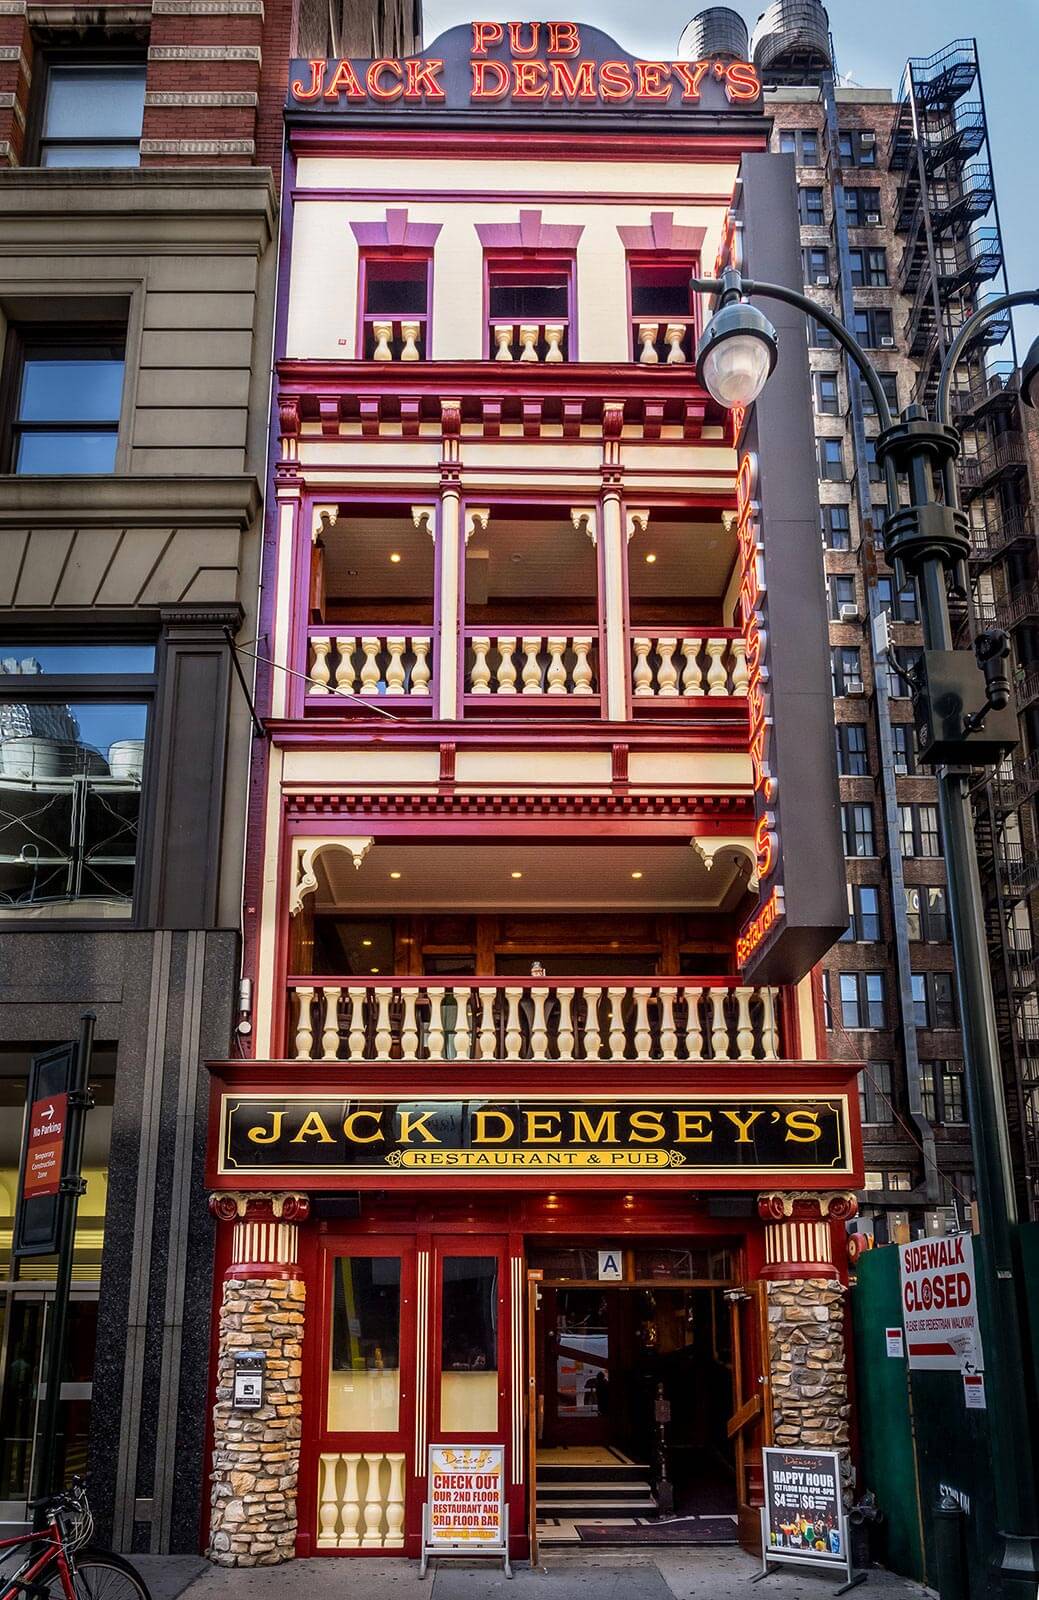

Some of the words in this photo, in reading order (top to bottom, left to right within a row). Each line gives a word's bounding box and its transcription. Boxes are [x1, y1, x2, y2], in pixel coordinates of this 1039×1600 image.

[472, 21, 581, 57] PUB
[292, 60, 446, 101] JACK
[472, 60, 760, 102] DEMSEY'S
[33, 1127, 41, 1137] No
[41, 1121, 62, 1135] Parking
[248, 1111, 442, 1144] JACK
[471, 1110, 823, 1144] DEMSEY'S
[34, 1150, 55, 1161] Temporary
[414, 1153, 578, 1165] RESTAURANT
[587, 1153, 601, 1165] &
[611, 1153, 659, 1165] PUB
[31, 1160, 56, 1171] Construction
[904, 1236, 965, 1274] SIDEWALK
[602, 1255, 619, 1273] A
[904, 1272, 971, 1313] CLOSED
[434, 1475, 473, 1490] CHECK
[475, 1475, 499, 1490] OUT
[772, 1470, 804, 1485] HAPPY
[806, 1473, 834, 1488] HOUR
[433, 1491, 452, 1502] OUR
[453, 1491, 471, 1502] 2ND
[473, 1491, 499, 1502] FLOOR
[774, 1492, 786, 1508] $4
[802, 1494, 815, 1510] $6
[433, 1504, 482, 1514] RESTAURANT
[483, 1504, 499, 1514] AND
[433, 1515, 451, 1526] 3RD
[453, 1515, 480, 1526] FLOOR
[481, 1515, 499, 1526] BAR
